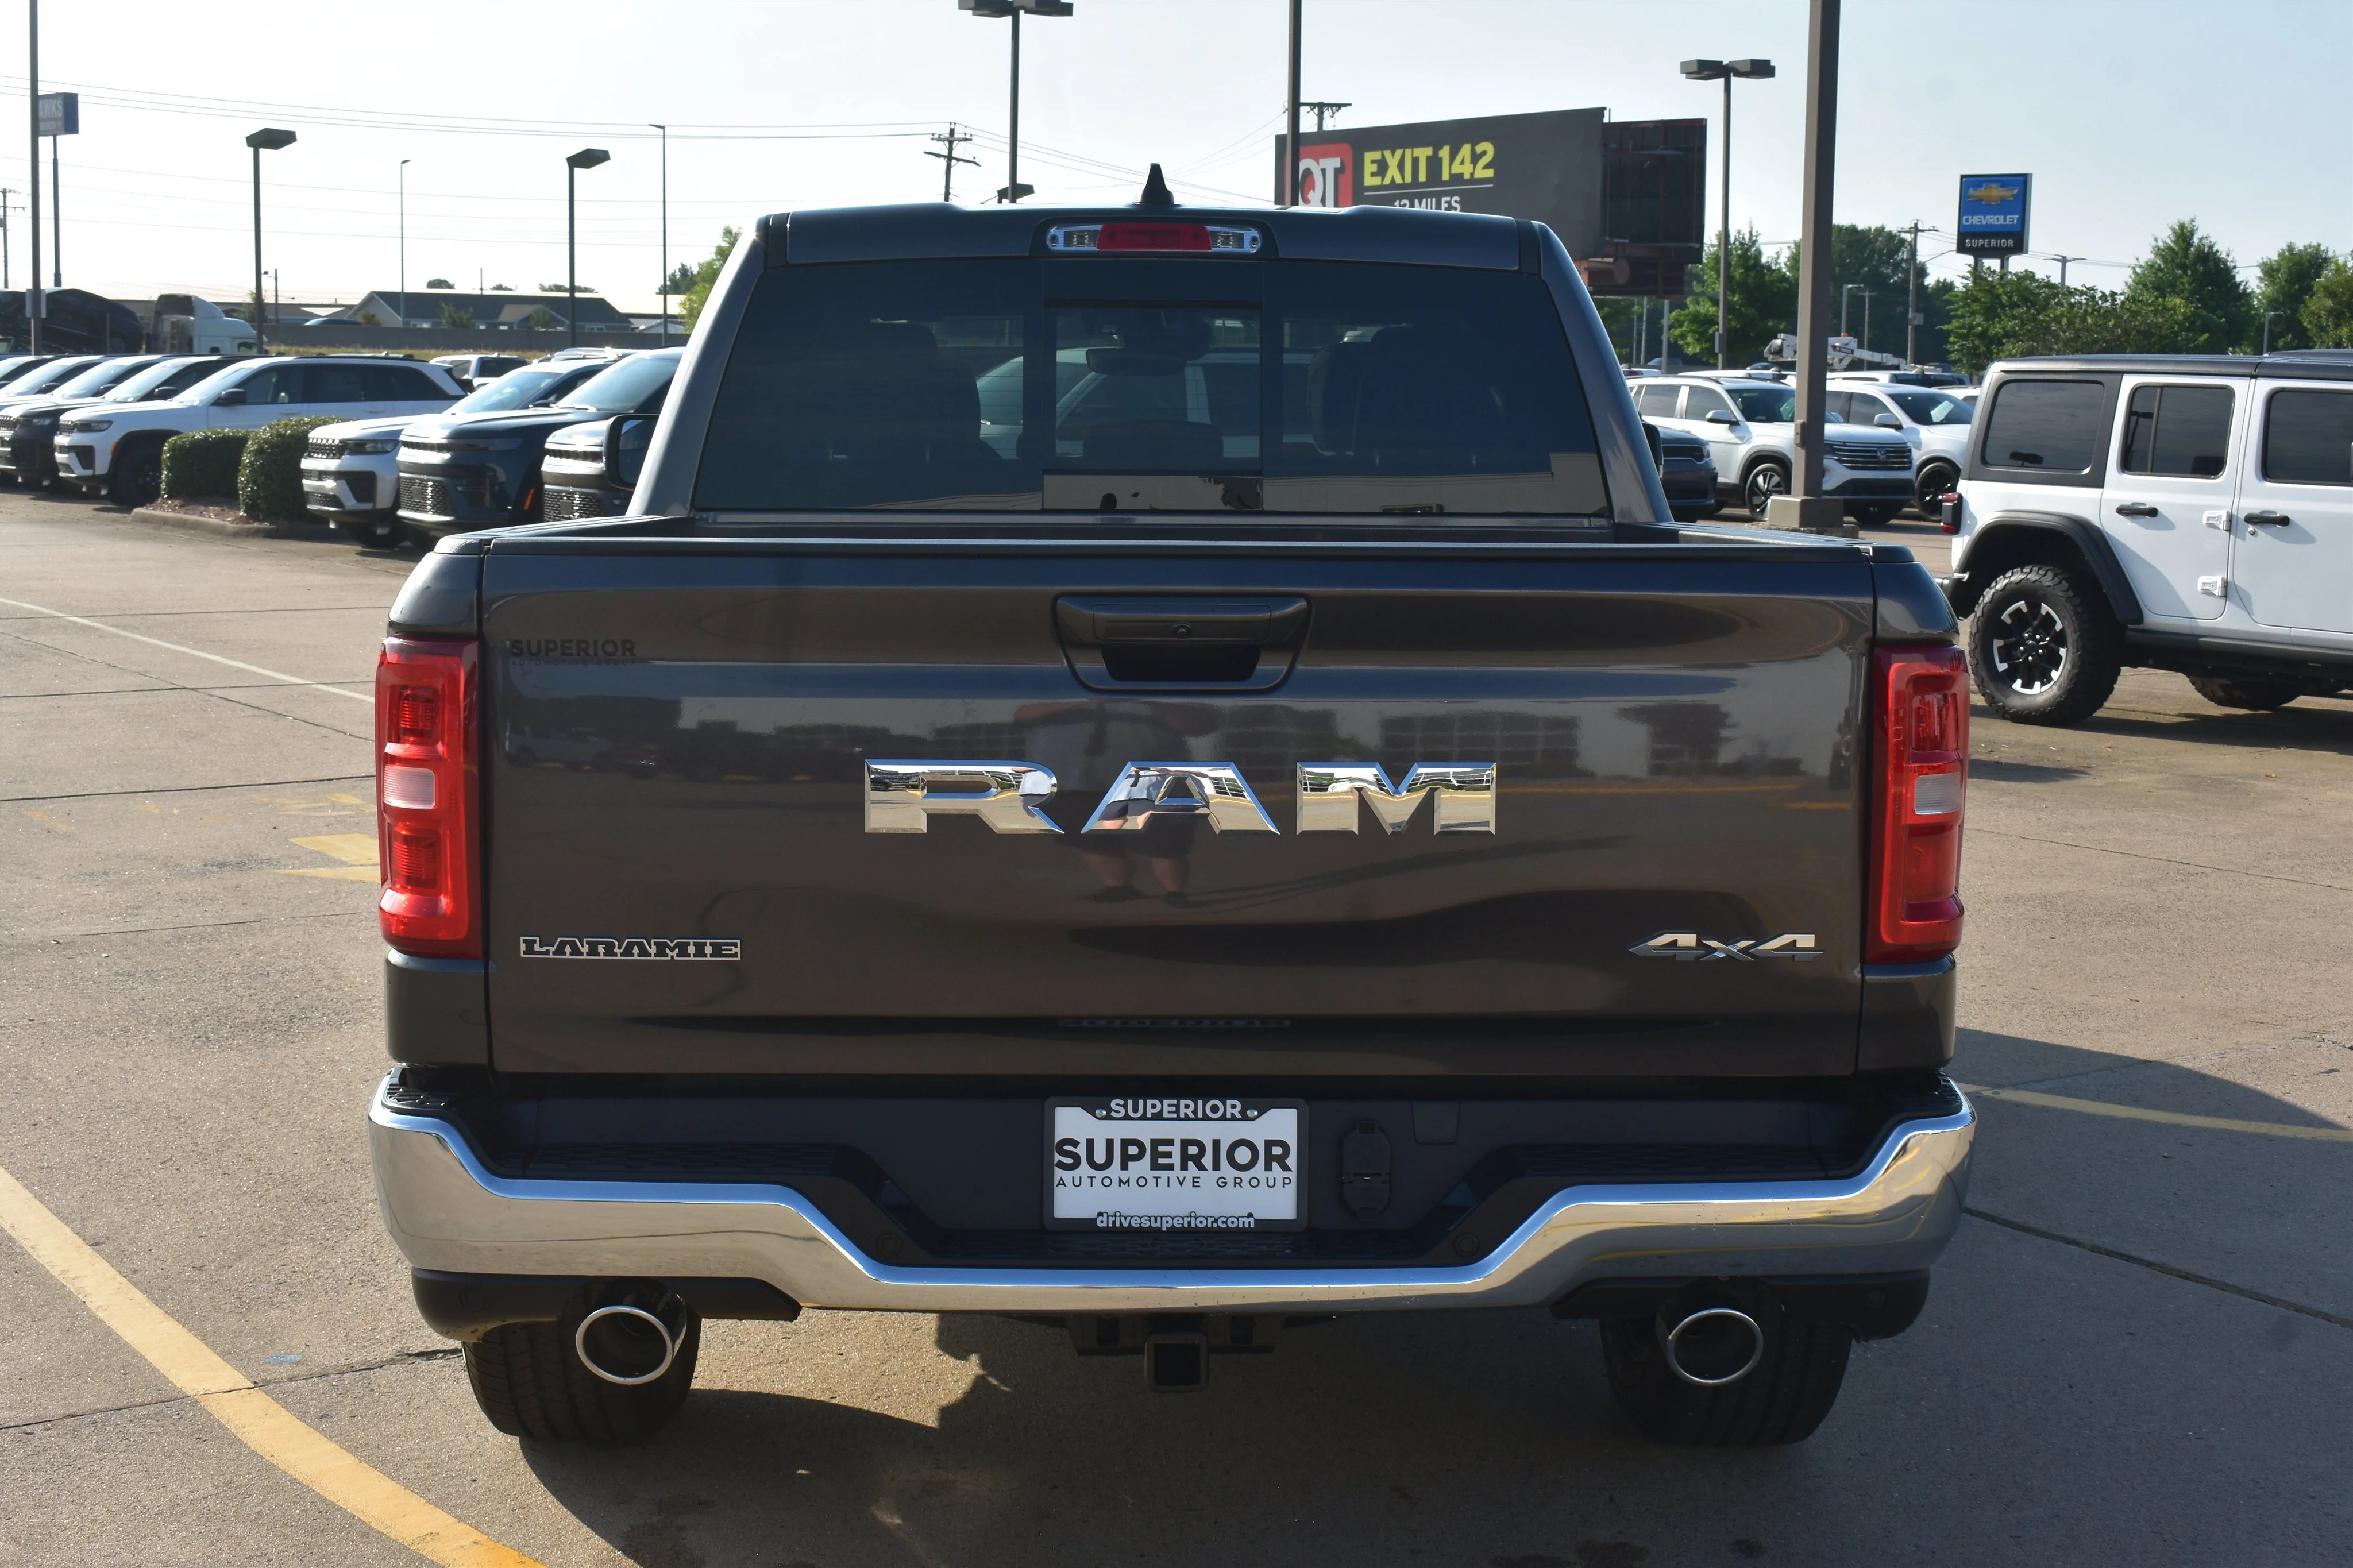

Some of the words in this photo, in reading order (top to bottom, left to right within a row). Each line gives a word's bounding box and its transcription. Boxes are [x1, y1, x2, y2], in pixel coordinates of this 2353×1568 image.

[1364, 146, 1433, 186] EXIT
[1438, 141, 1494, 181] 142
[1299, 157, 1341, 207] QT
[1962, 215, 2019, 225] CHEVROLET
[1965, 239, 2013, 248] SUPERIOR
[511, 639, 637, 657] SUPERIOR
[865, 759, 1496, 835] RAM
[520, 936, 741, 961] LARAMIE
[1110, 1099, 1243, 1119] SUPERIOR
[1054, 1137, 1293, 1172] SUPERIOR
[1055, 1176, 1201, 1188] AUTOMOTIVE
[1216, 1176, 1293, 1188] GROUP
[1096, 1211, 1255, 1231] drivesuperior.com
